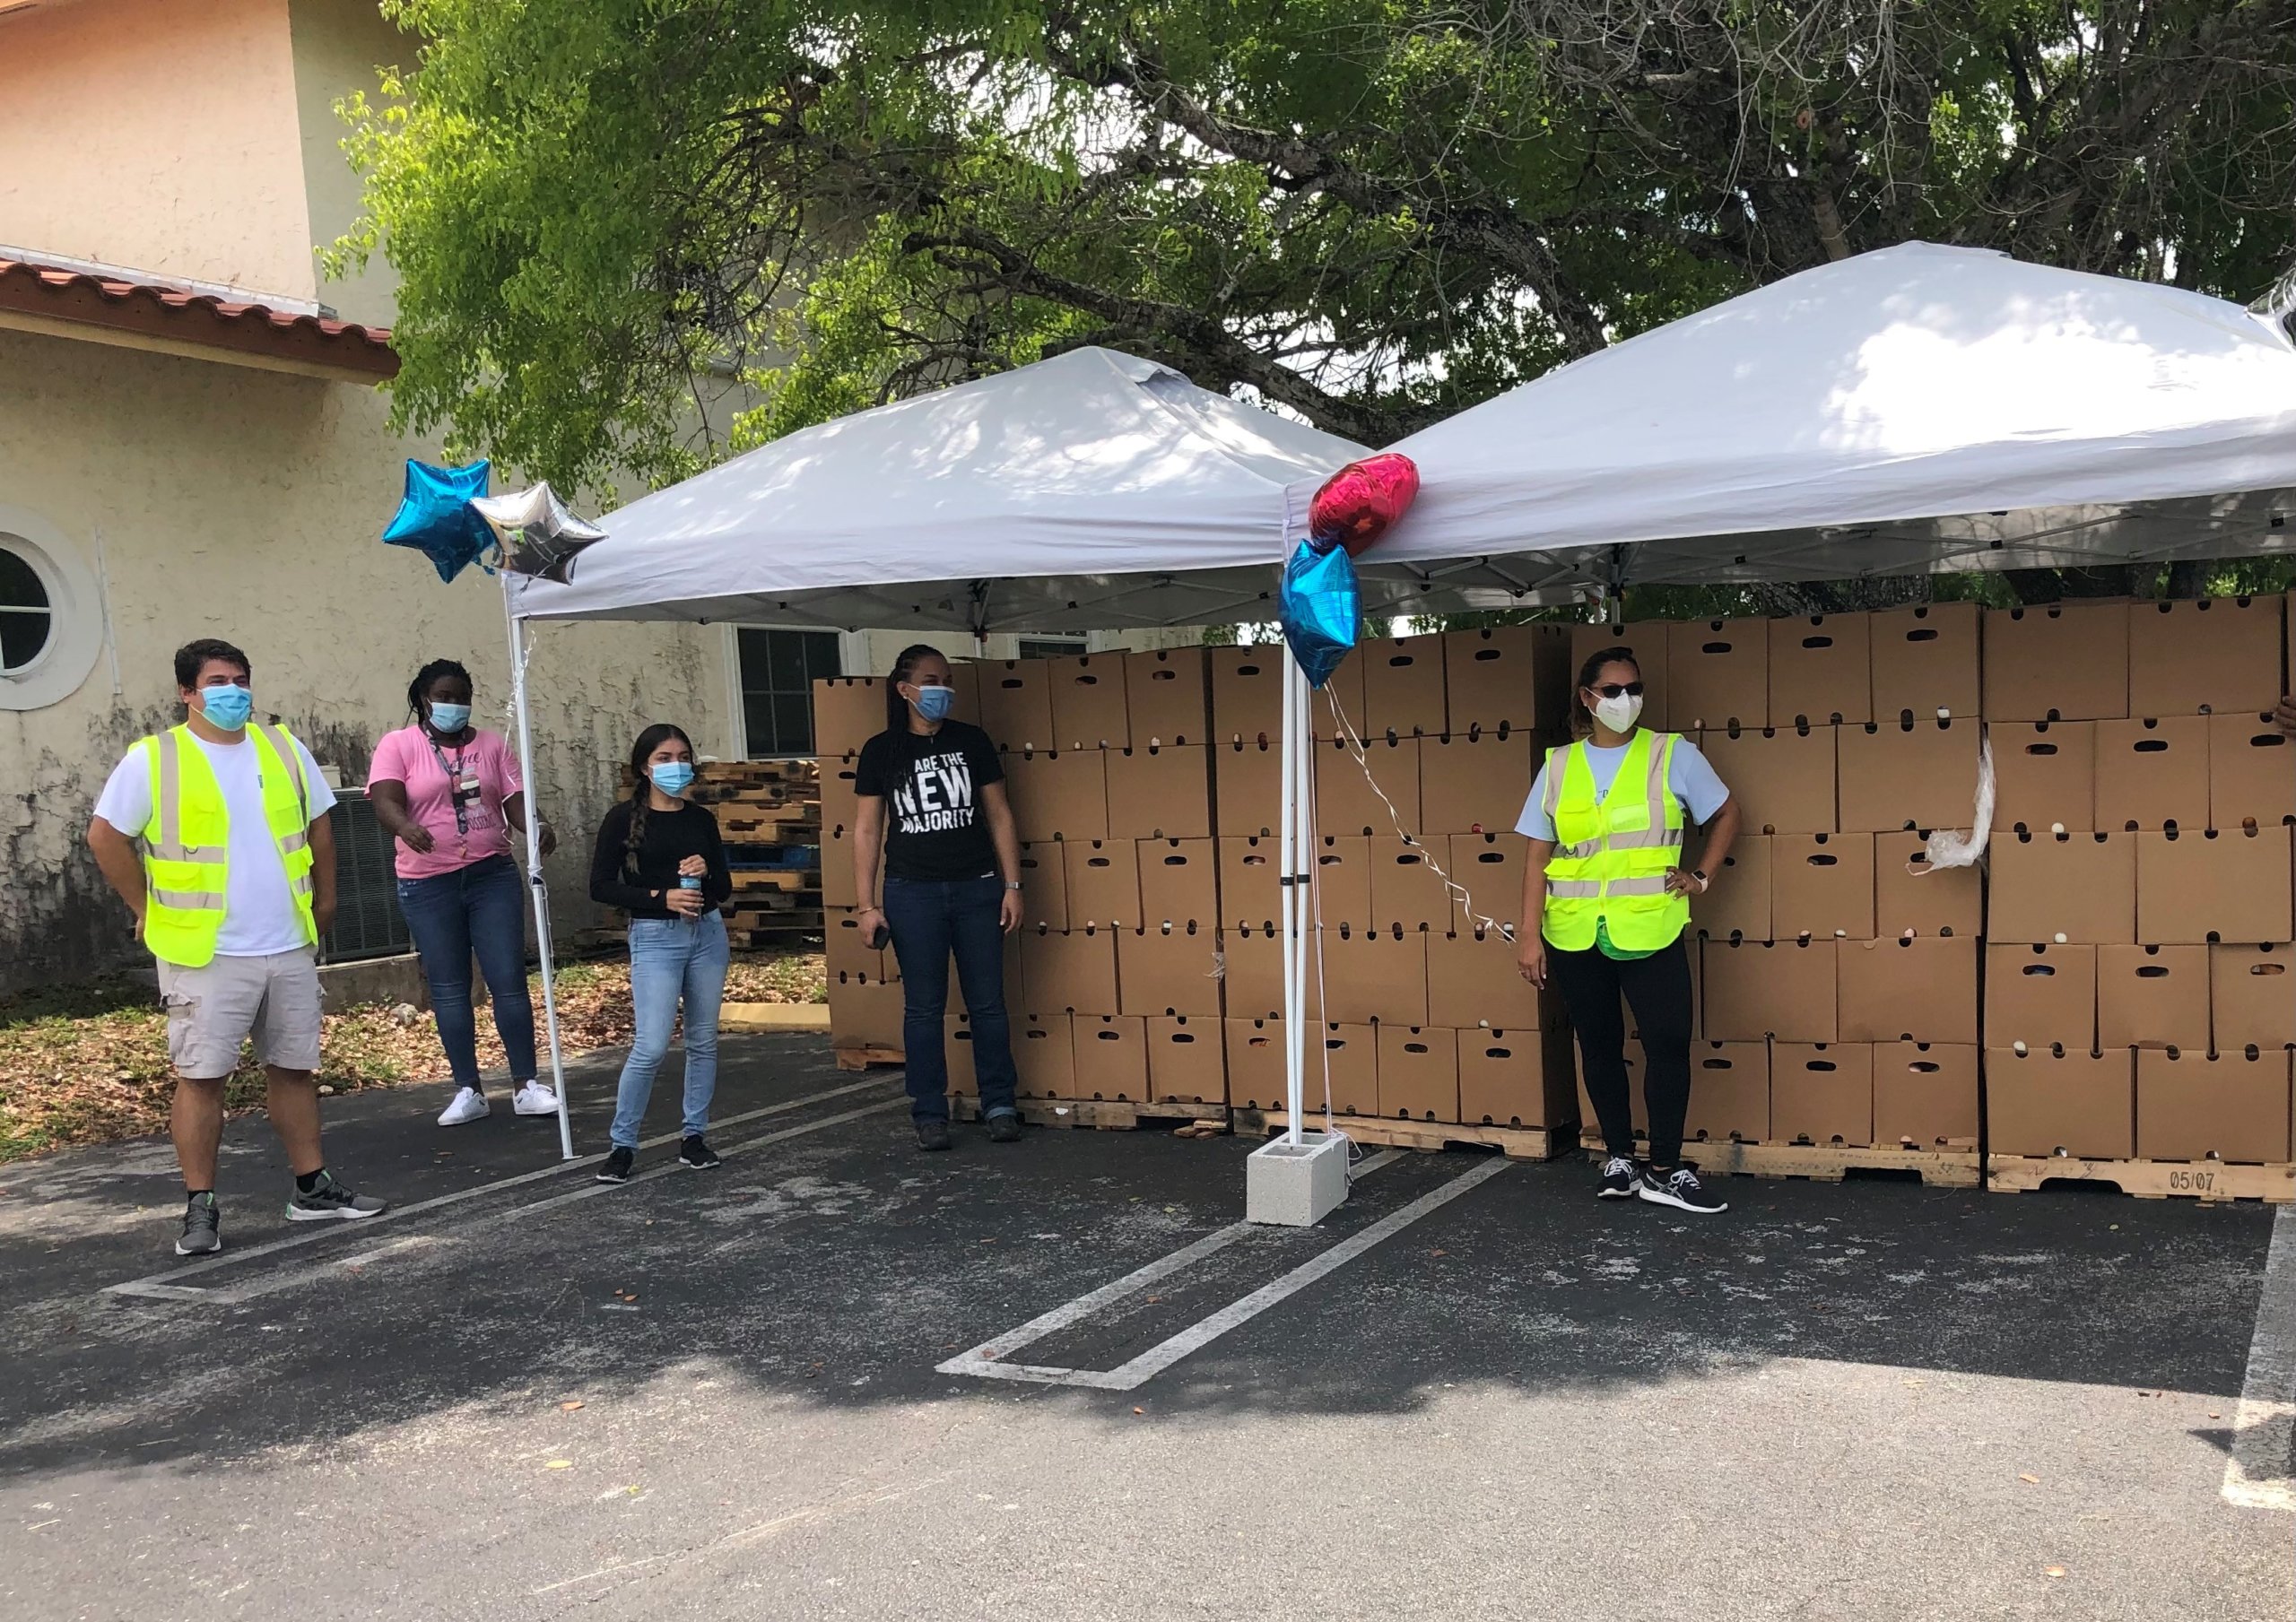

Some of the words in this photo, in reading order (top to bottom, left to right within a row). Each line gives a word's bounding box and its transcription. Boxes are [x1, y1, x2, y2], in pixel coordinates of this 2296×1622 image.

[915, 755, 940, 773] ARE
[941, 751, 967, 768] THE
[893, 767, 971, 817] NEW
[900, 806, 975, 834] MAJORITY
[2170, 1171, 2214, 1191] 05/07
